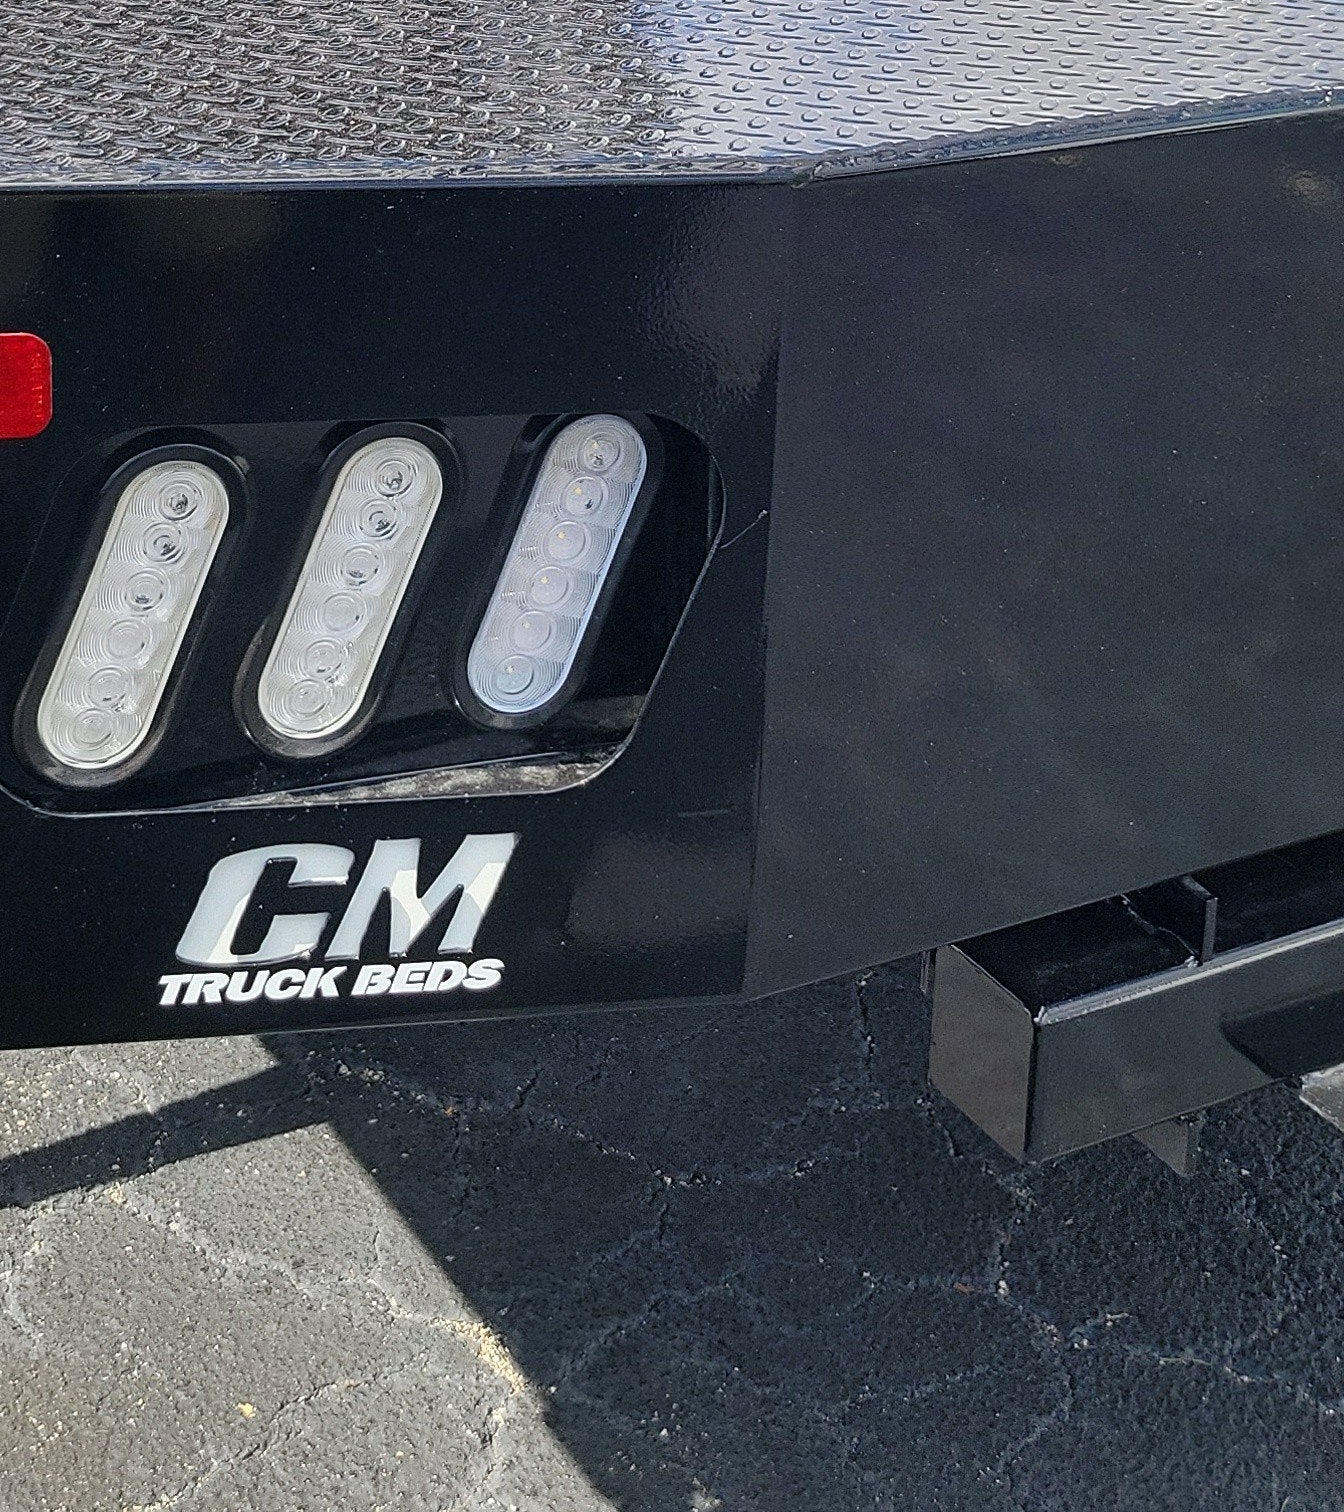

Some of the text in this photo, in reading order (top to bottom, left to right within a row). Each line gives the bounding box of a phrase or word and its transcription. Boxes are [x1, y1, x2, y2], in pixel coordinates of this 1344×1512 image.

[175, 832, 521, 967] CM
[157, 958, 506, 1006] TRUCK BEDS
